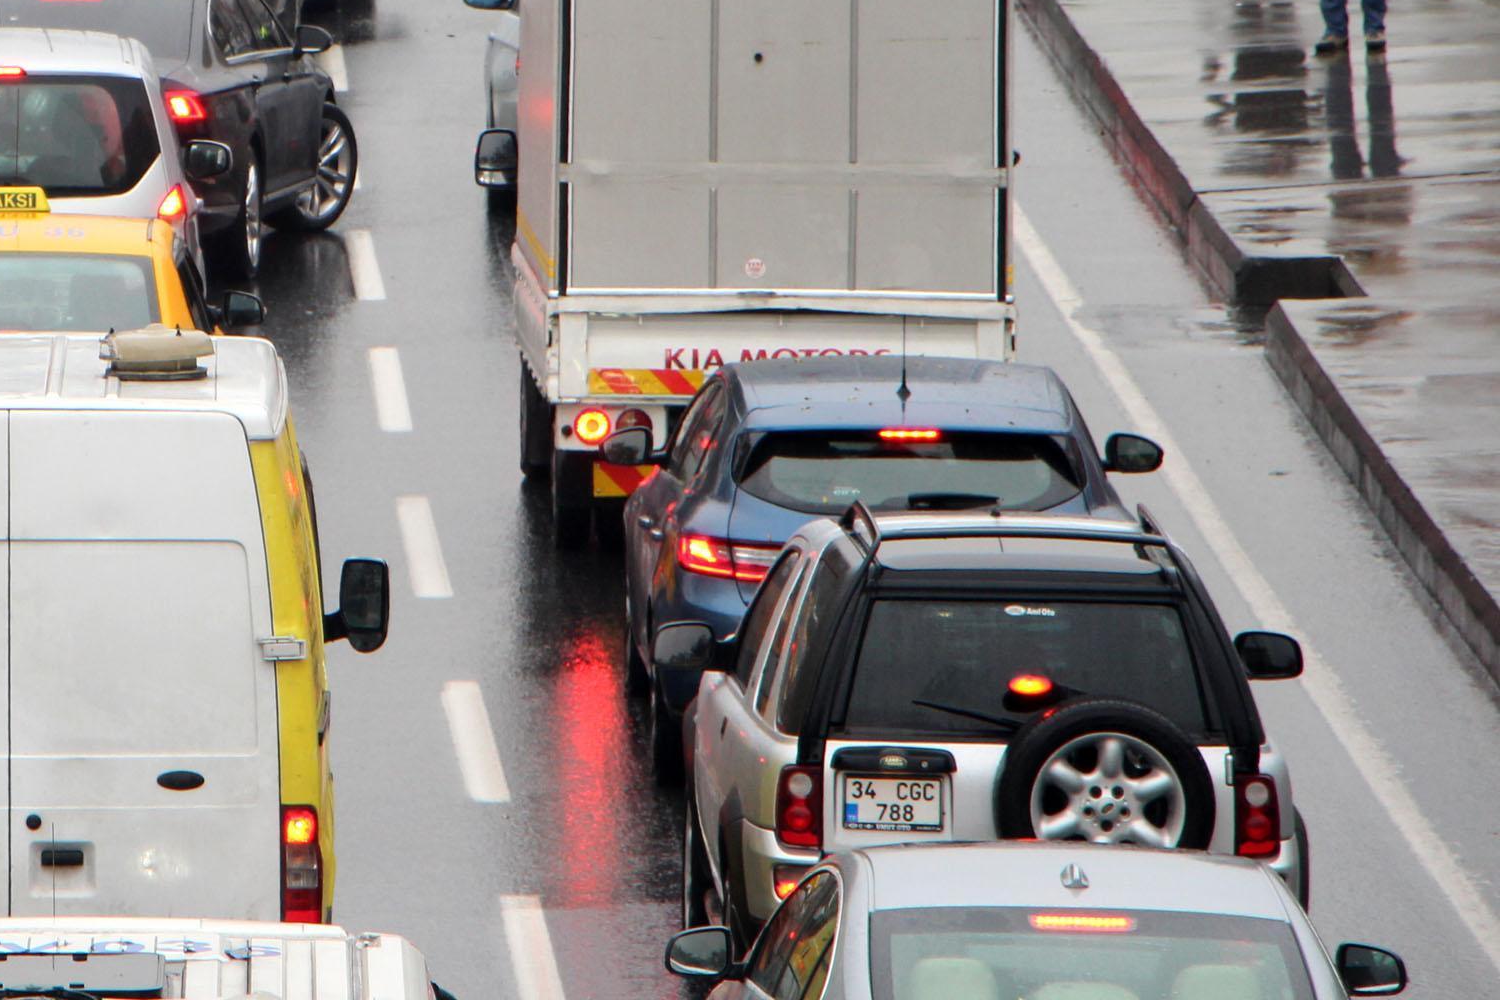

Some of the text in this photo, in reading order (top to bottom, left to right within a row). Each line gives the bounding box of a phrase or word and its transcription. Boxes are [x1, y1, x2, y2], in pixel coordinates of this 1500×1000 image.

[665, 348, 725, 370] KIA
[851, 781, 935, 801] 34 CGC
[876, 803, 914, 822] 788
